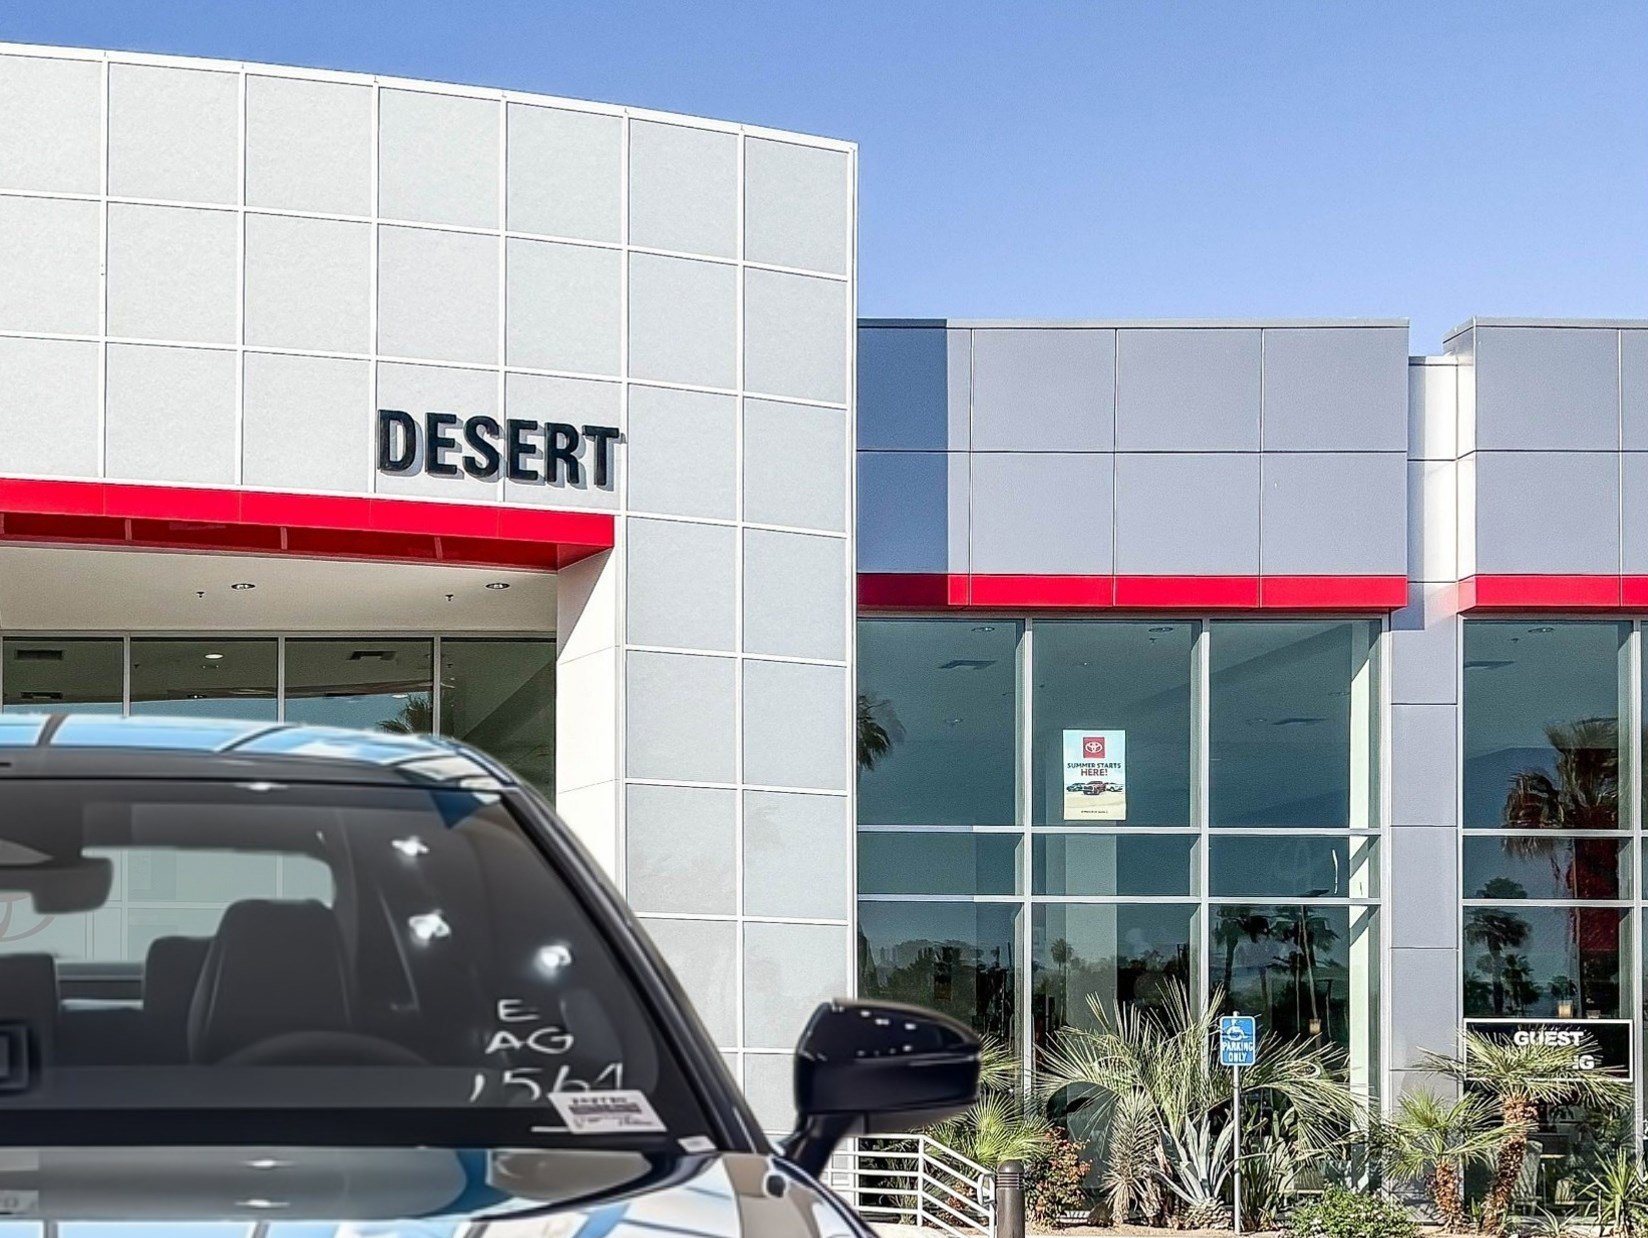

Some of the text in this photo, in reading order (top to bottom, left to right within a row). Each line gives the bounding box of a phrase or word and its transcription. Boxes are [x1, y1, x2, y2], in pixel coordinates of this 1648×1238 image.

[377, 409, 619, 486] DESERT
[1081, 768, 1108, 776] HERE!
[497, 999, 541, 1022] E
[485, 1027, 574, 1054] AG
[1222, 1041, 1253, 1052] PARKING
[1513, 1030, 1584, 1047] GUEST
[1228, 1051, 1247, 1063] ONLY
